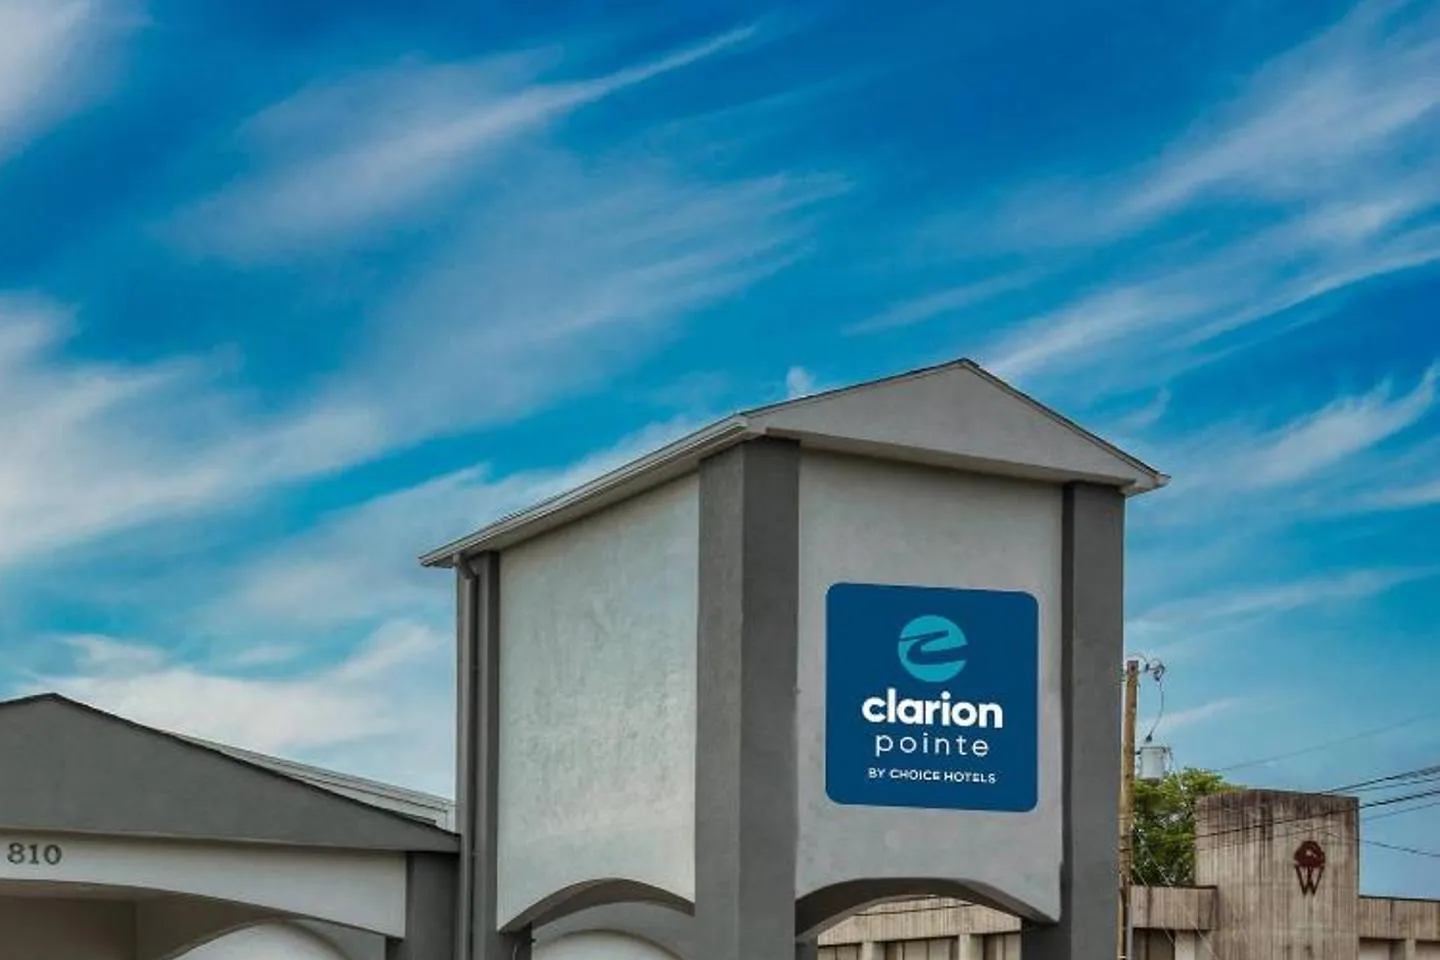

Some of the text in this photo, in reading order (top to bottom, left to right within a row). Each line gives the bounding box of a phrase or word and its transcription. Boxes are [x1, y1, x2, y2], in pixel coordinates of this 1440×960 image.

[862, 687, 1003, 728] clarion
[875, 732, 989, 758] pointe
[868, 767, 997, 784] BY CHOICE HOTELS
[7, 842, 62, 866] 810
